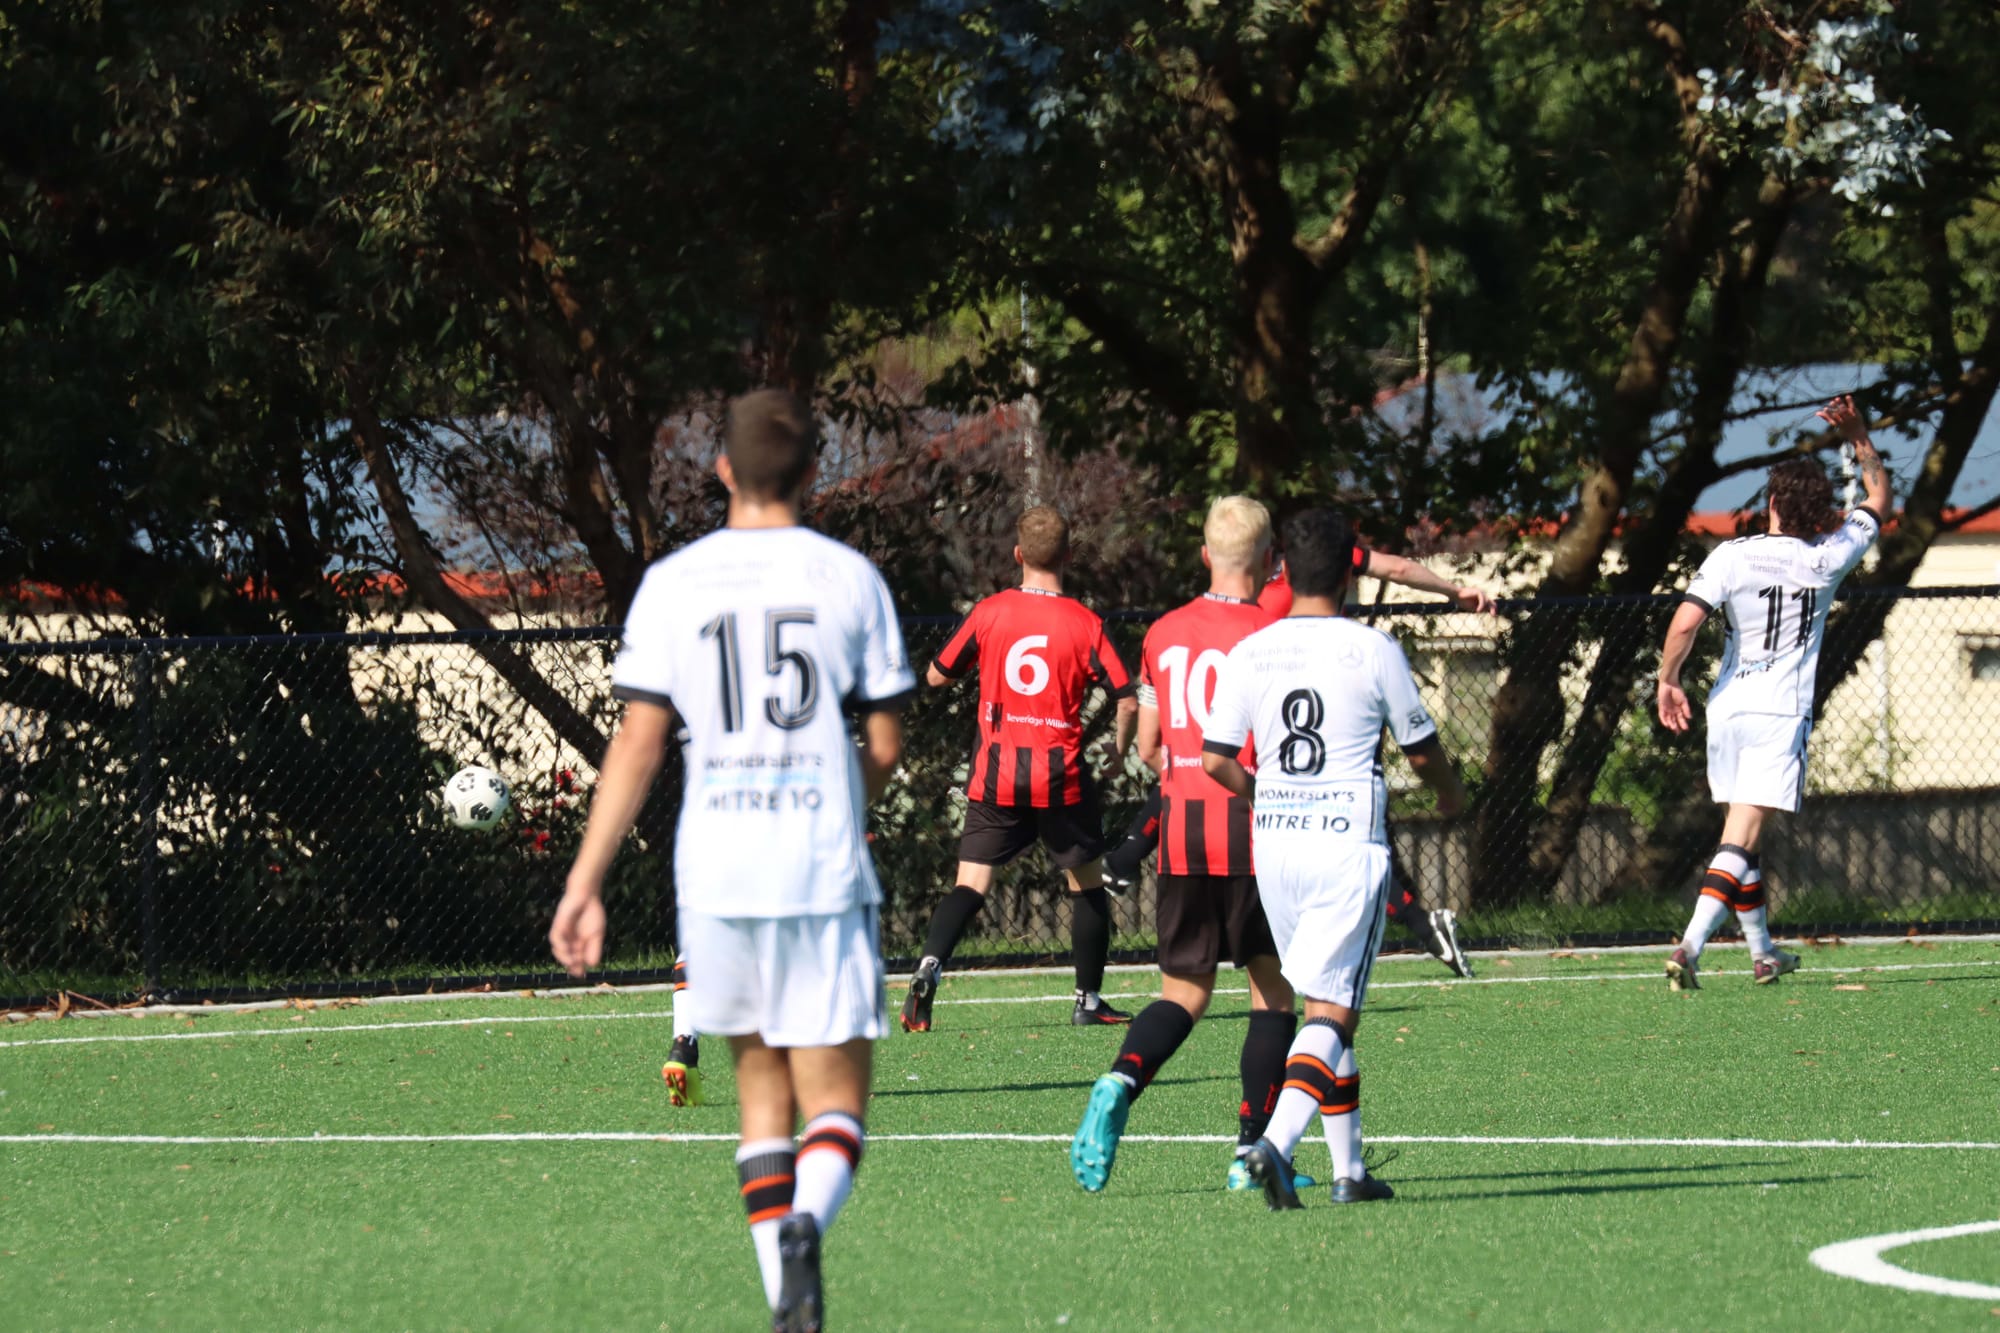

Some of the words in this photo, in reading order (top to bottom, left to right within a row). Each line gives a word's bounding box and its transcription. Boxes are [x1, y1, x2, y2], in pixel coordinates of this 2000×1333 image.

[1759, 585, 1816, 652] 11
[699, 606, 819, 733] 15
[1005, 635, 1050, 696] 6
[1158, 645, 1226, 733] 10
[1174, 755, 1203, 768] Beveri
[1279, 688, 1326, 776] 8
[789, 788, 824, 812] 10
[1255, 814, 1313, 831] MITRE
[1321, 815, 1351, 834] 10
[1257, 788, 1356, 803] WOMERSLEY'S
